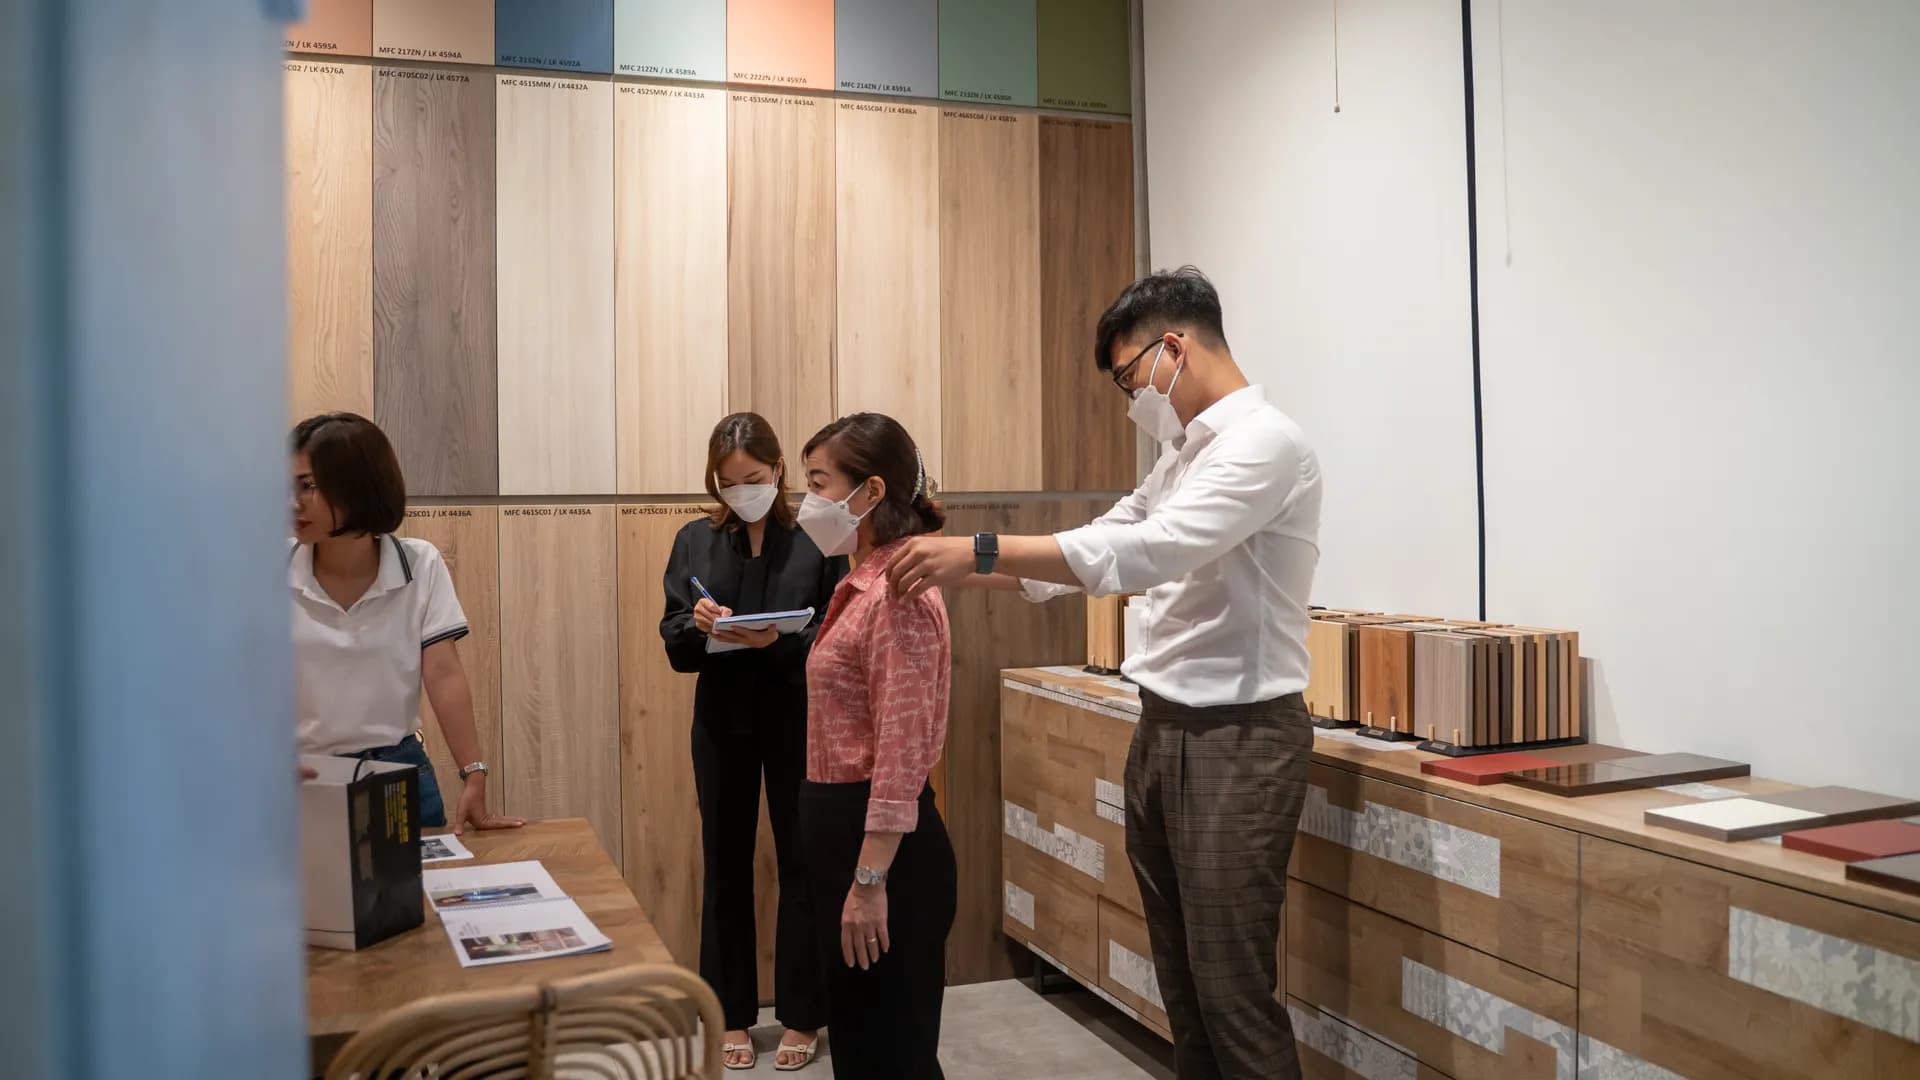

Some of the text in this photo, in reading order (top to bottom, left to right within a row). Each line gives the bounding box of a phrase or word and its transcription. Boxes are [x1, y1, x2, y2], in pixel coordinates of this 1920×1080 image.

[501, 55, 517, 63] MFC
[320, 66, 344, 74] 4576A
[436, 73, 445, 81] LK
[733, 72, 748, 80] MFC
[944, 89, 958, 97] MFC
